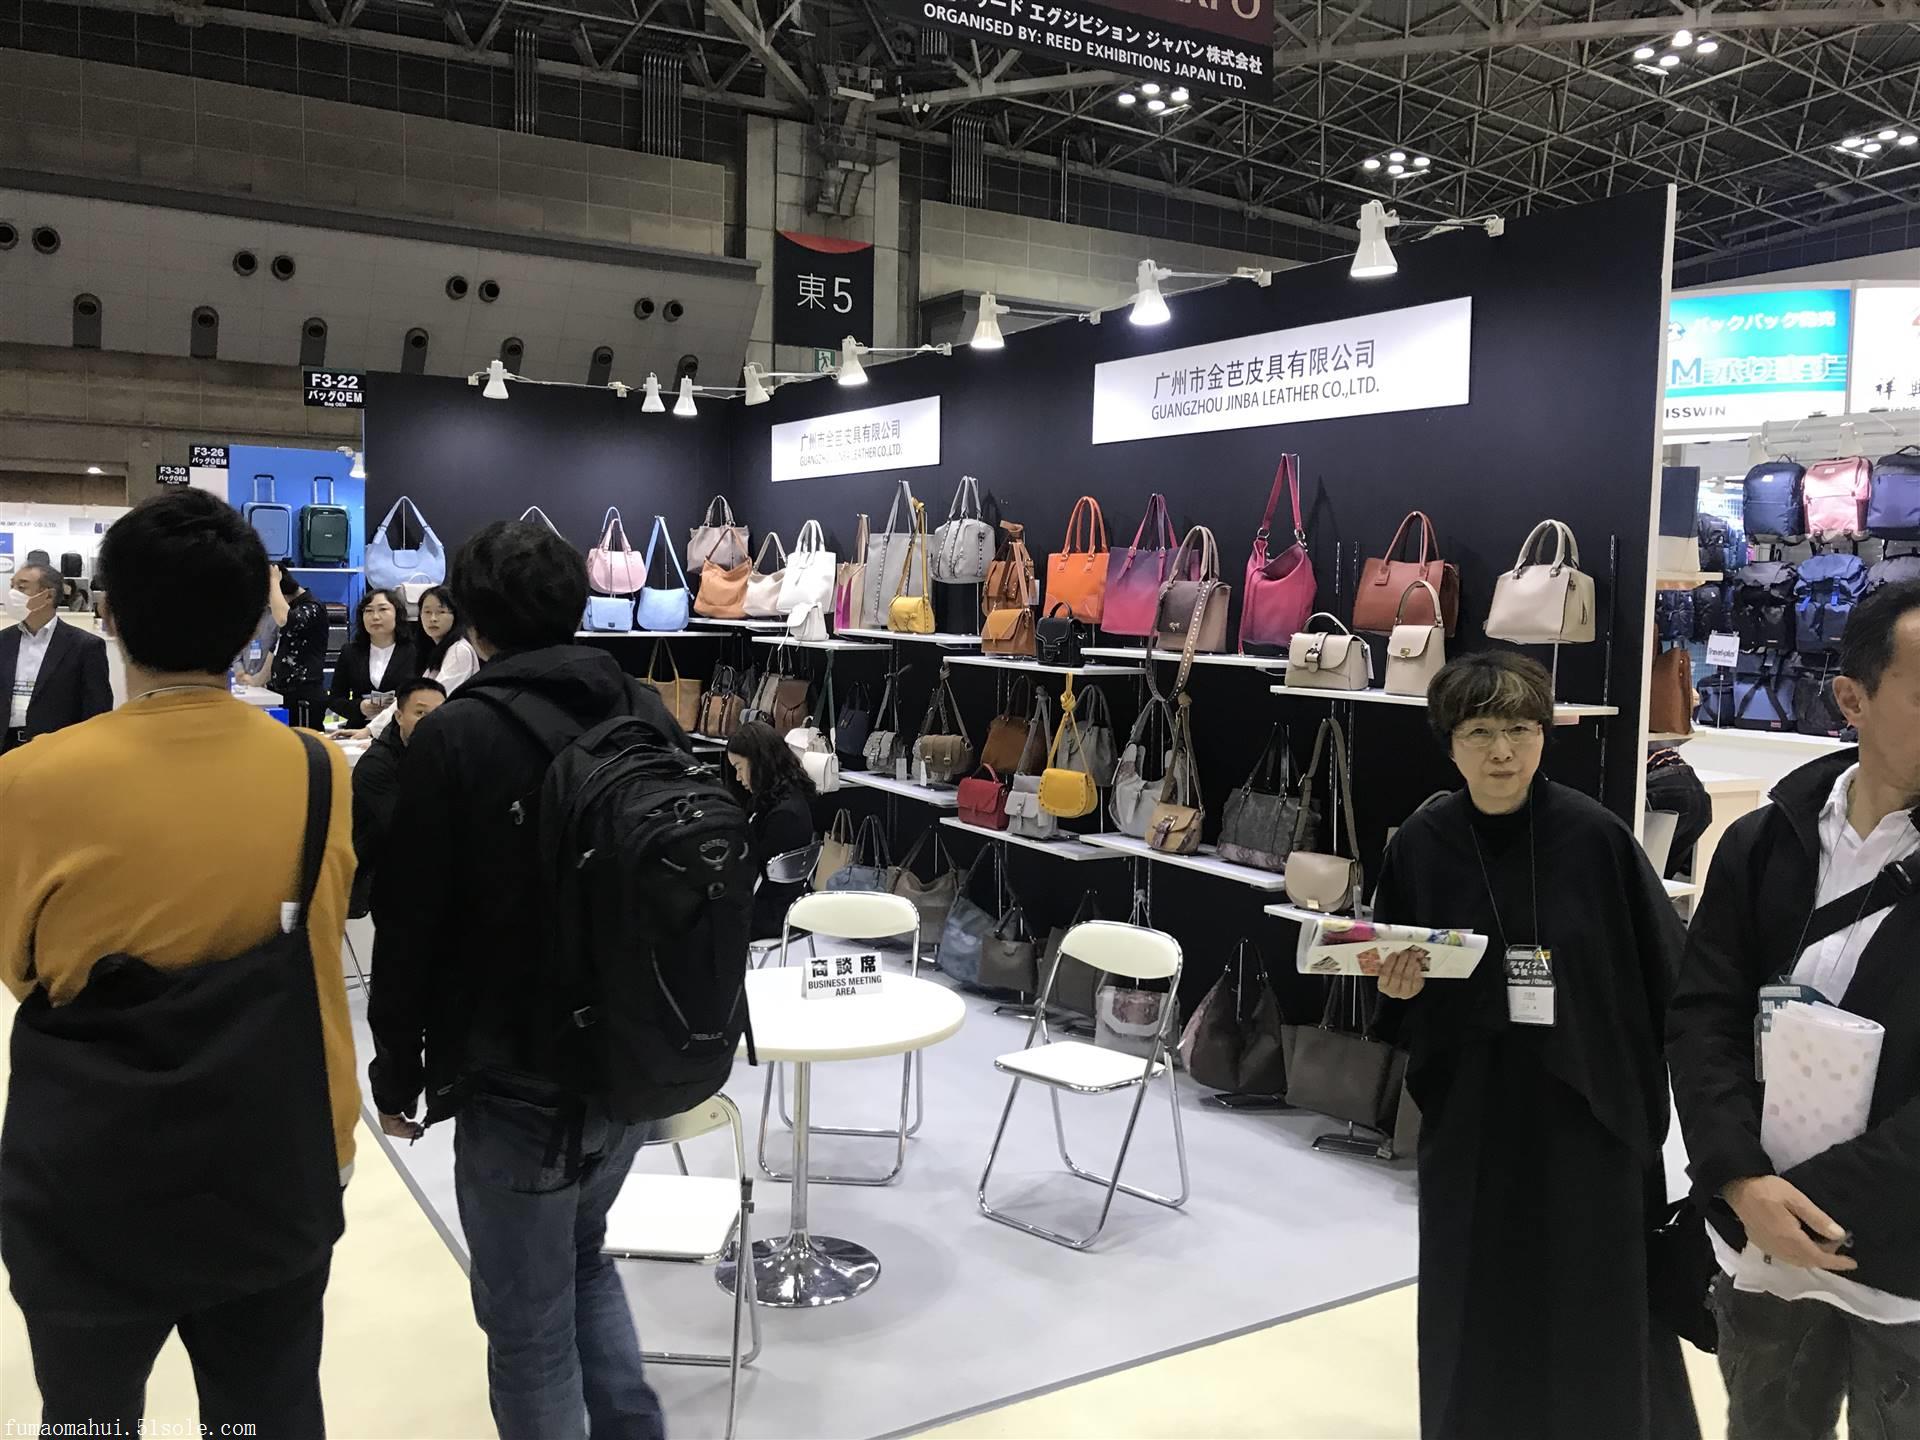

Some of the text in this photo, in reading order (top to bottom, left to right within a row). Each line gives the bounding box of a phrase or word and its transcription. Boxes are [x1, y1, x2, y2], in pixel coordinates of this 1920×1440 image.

[923, 3, 1247, 90] ORGANISED BY: REED EXHIBITIONS JAPAN LTD.
[1029, 4, 1140, 43] エグジビション
[1145, 31, 1263, 75] ジャパン株式会社
[1154, 339, 1375, 399] 广州市金芭皮具有限公司
[311, 373, 359, 389] F3-22
[308, 390, 363, 403] バッグOEM
[1151, 396, 1223, 420] GUANGZHOU
[1225, 391, 1259, 411] JINBA
[1263, 383, 1319, 406] LEATHER
[194, 447, 225, 457] F3-26
[160, 466, 186, 475] F3-30
[811, 955, 877, 978] 商談席
[808, 975, 882, 989] BUSINESS MEETING
[835, 987, 856, 996] AREA
